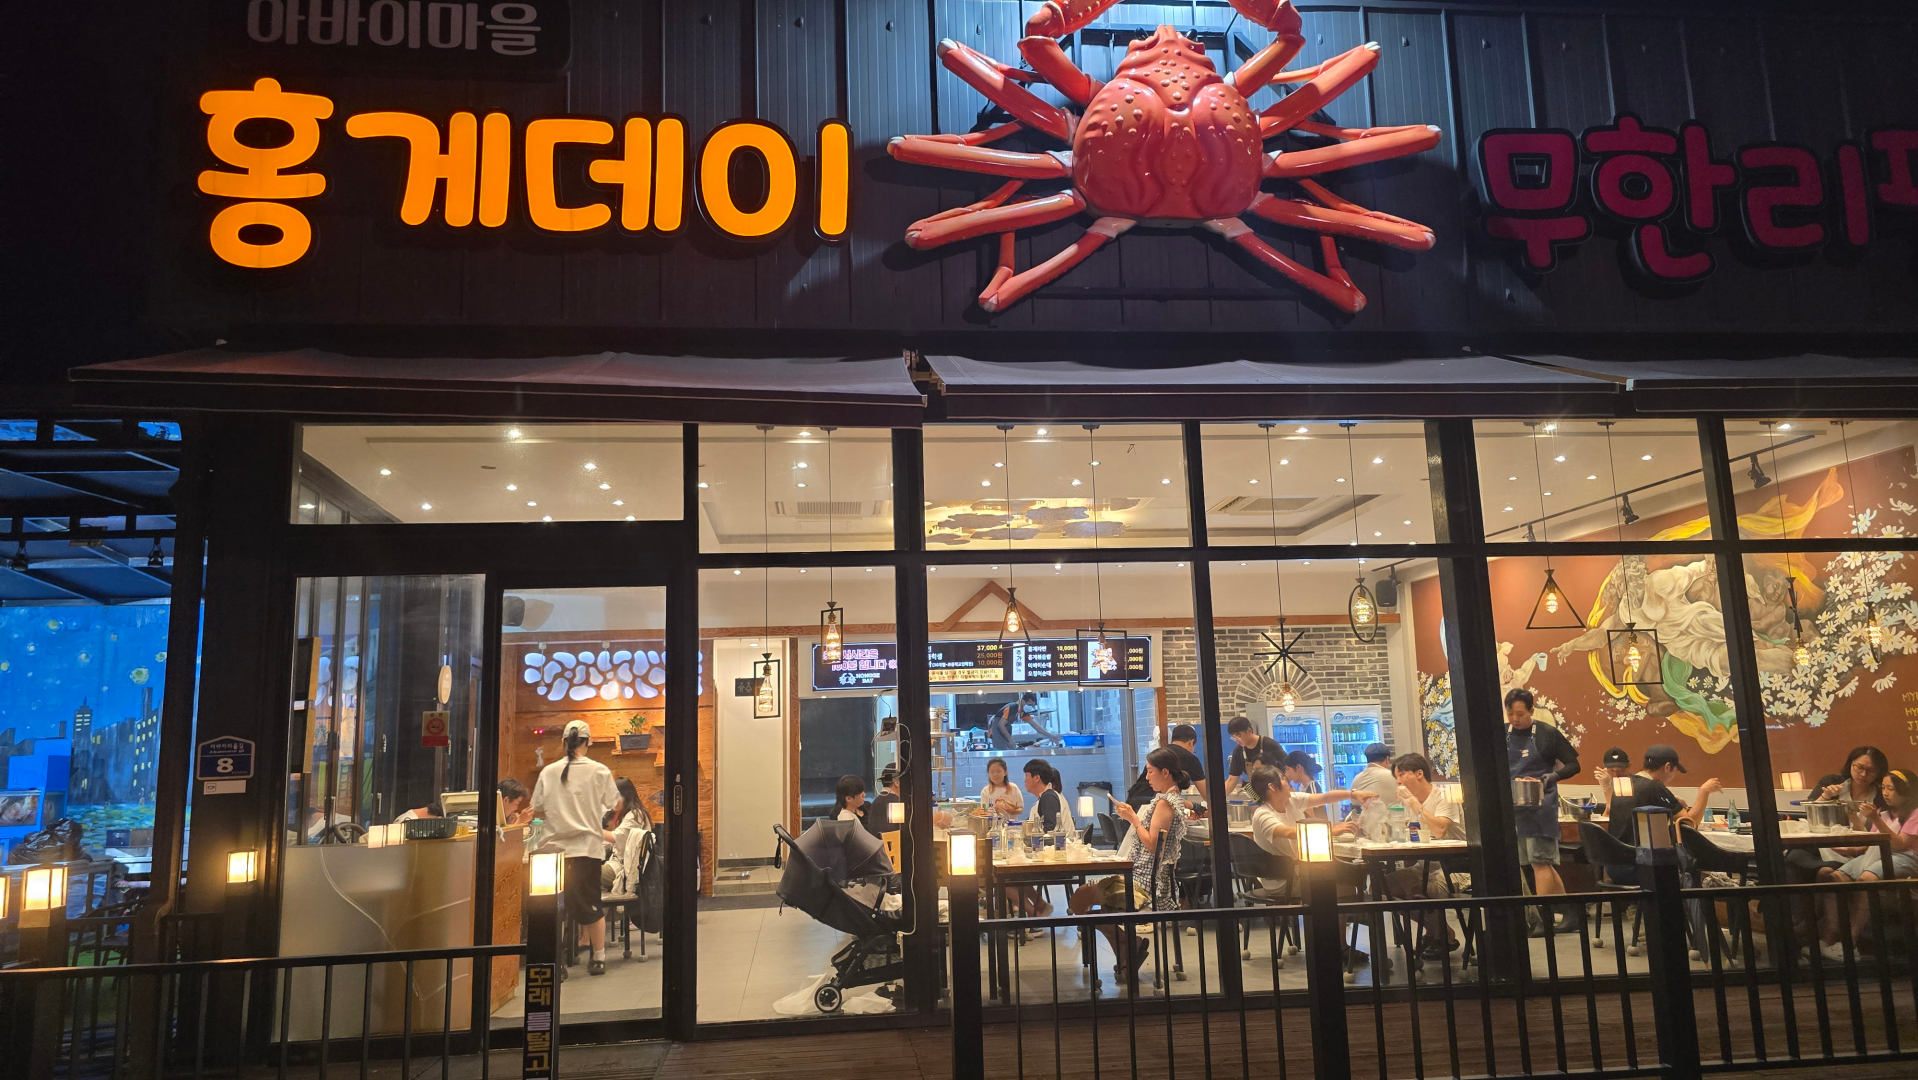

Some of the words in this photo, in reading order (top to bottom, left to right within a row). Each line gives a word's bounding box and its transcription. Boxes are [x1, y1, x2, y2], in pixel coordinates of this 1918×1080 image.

[247, 0, 541, 56] 아바이마을
[198, 77, 848, 269] 홍게데이
[859, 659, 887, 670] 입니다
[216, 758, 234, 773] 8
[527, 968, 552, 1031] 모래를
[525, 1032, 550, 1072] 털고
